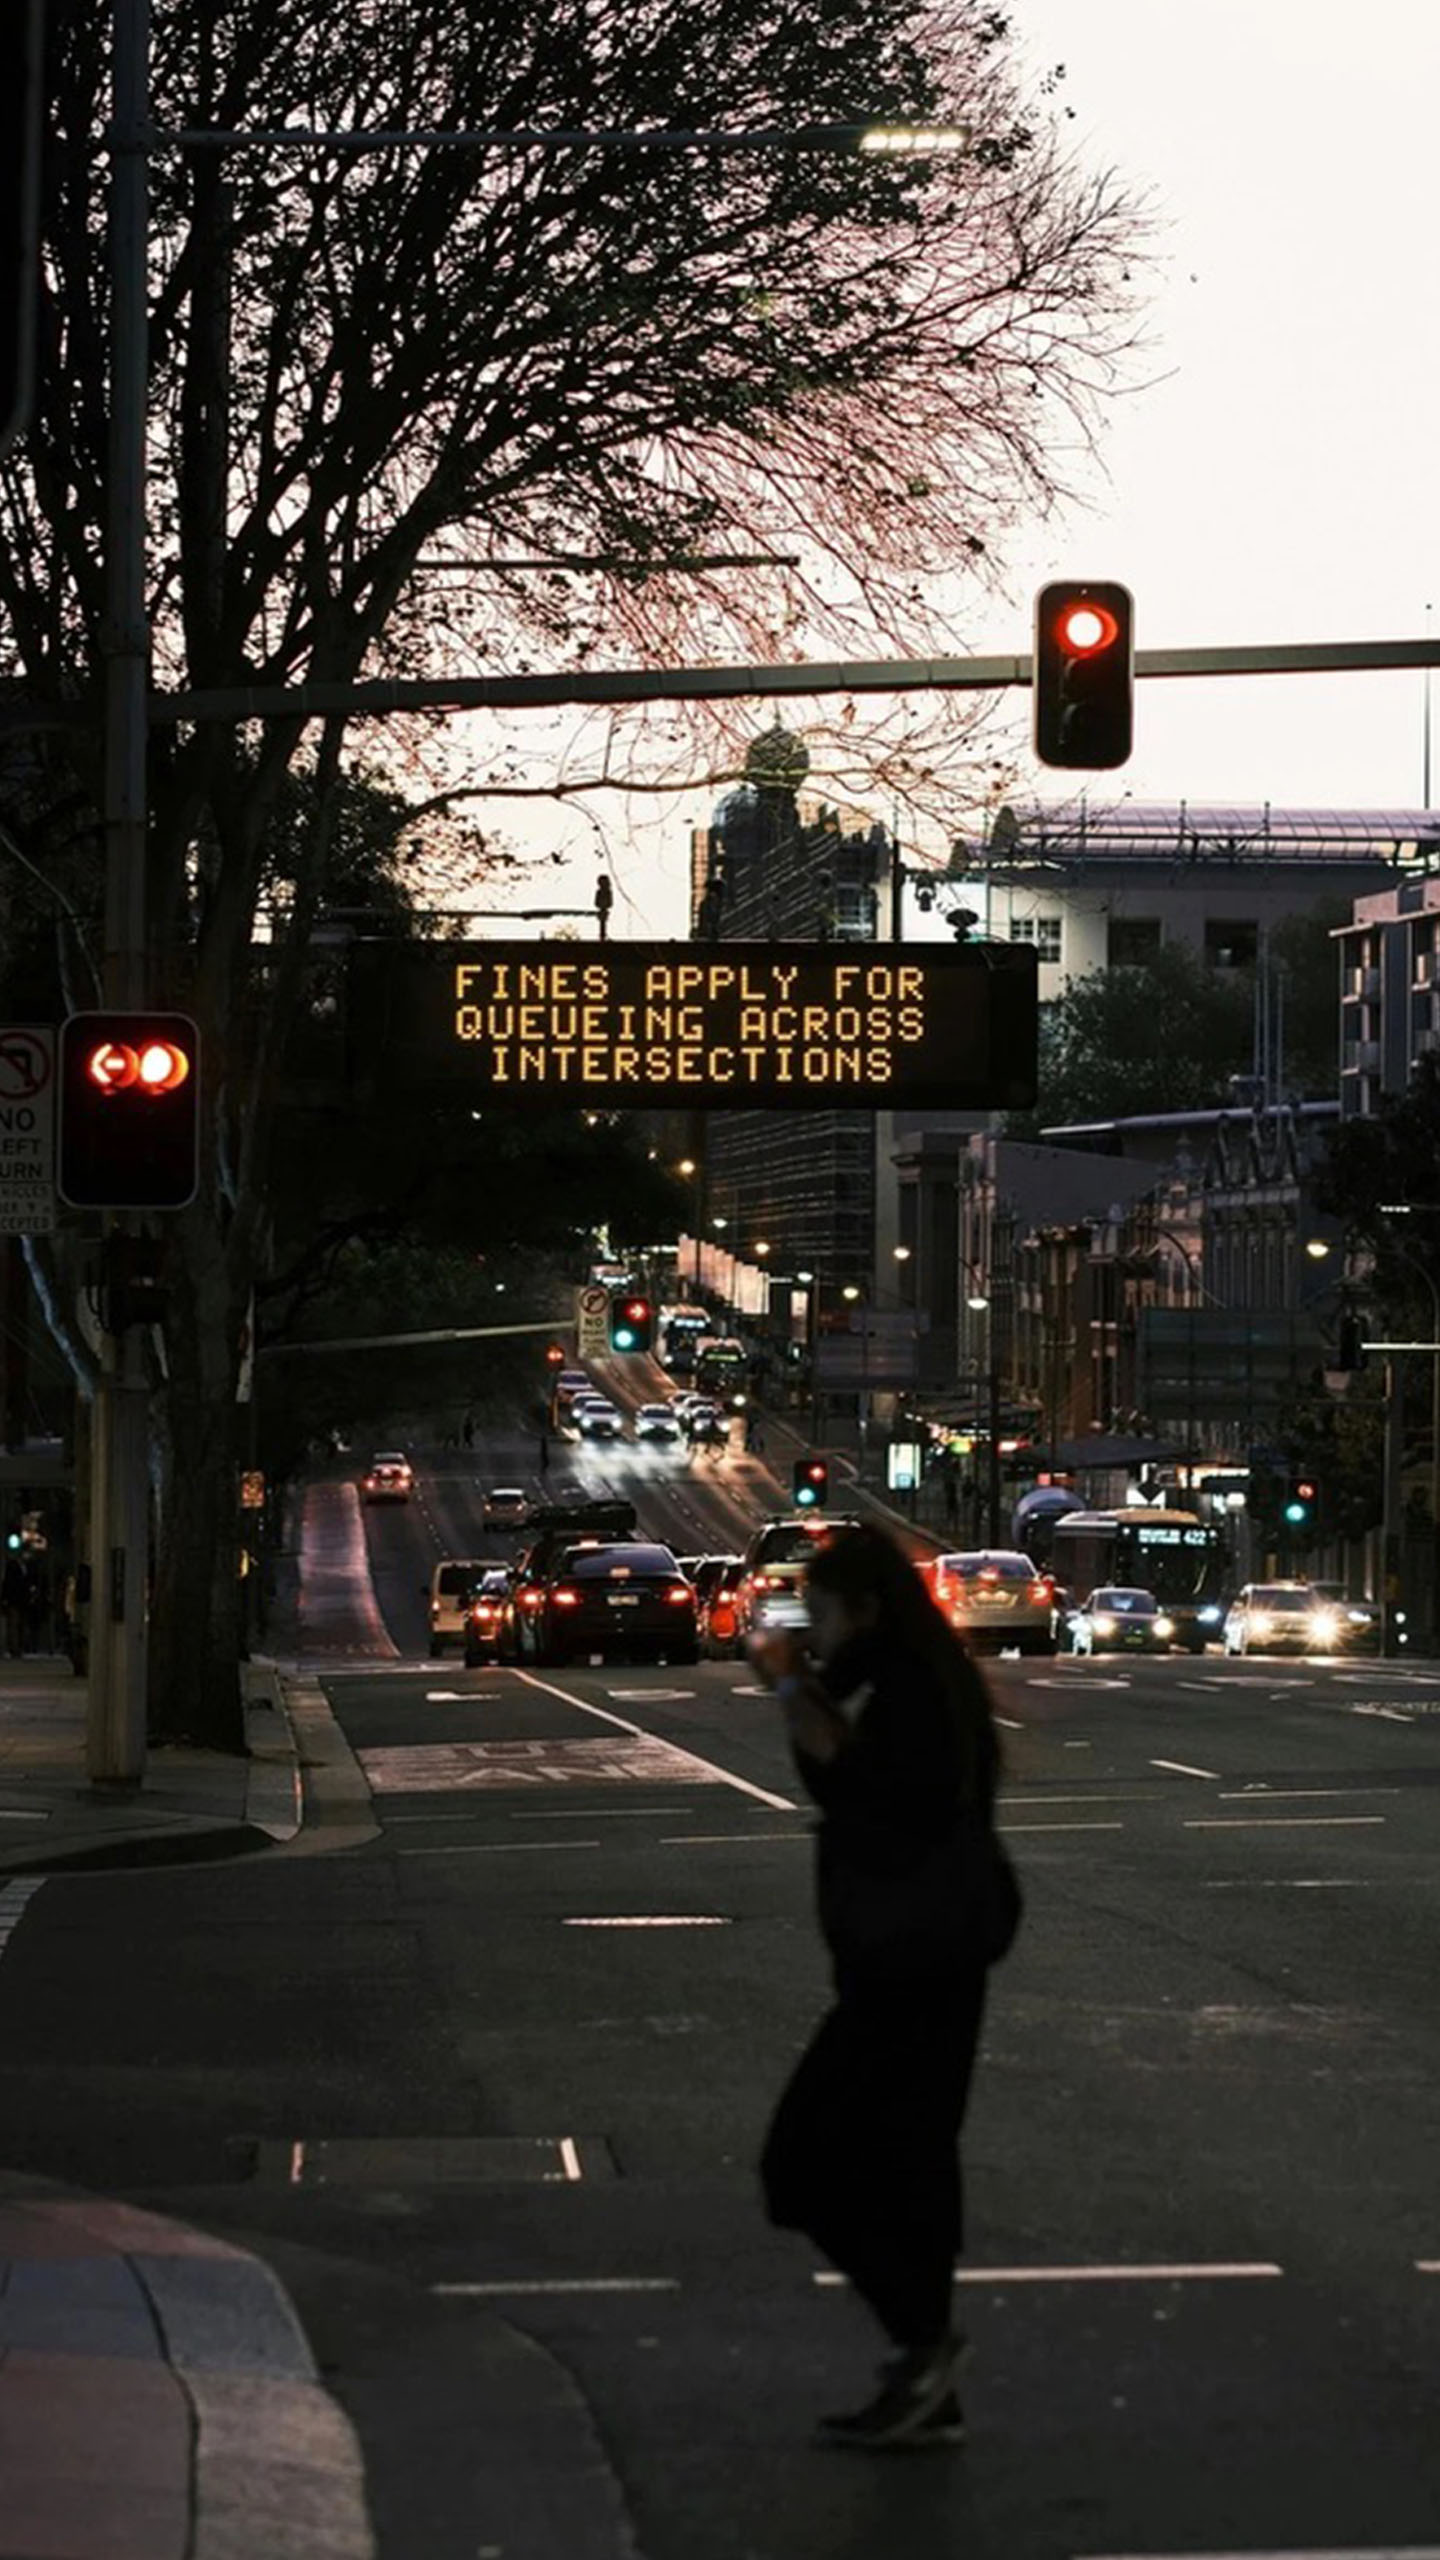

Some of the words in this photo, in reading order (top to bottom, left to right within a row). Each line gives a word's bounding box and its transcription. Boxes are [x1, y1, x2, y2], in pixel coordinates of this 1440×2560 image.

[456, 964, 609, 1001] FINES
[645, 964, 798, 1001] APPLY
[835, 964, 925, 1001] FOR
[455, 1005, 704, 1042] QUEUEING
[740, 1005, 925, 1042] ACROSS
[492, 1045, 893, 1082] INTERSECTIONS
[0, 1137, 42, 1156] EFT
[0, 1161, 43, 1179] URN
[584, 1317, 604, 1327] NO
[1183, 1528, 1207, 1546] 422
